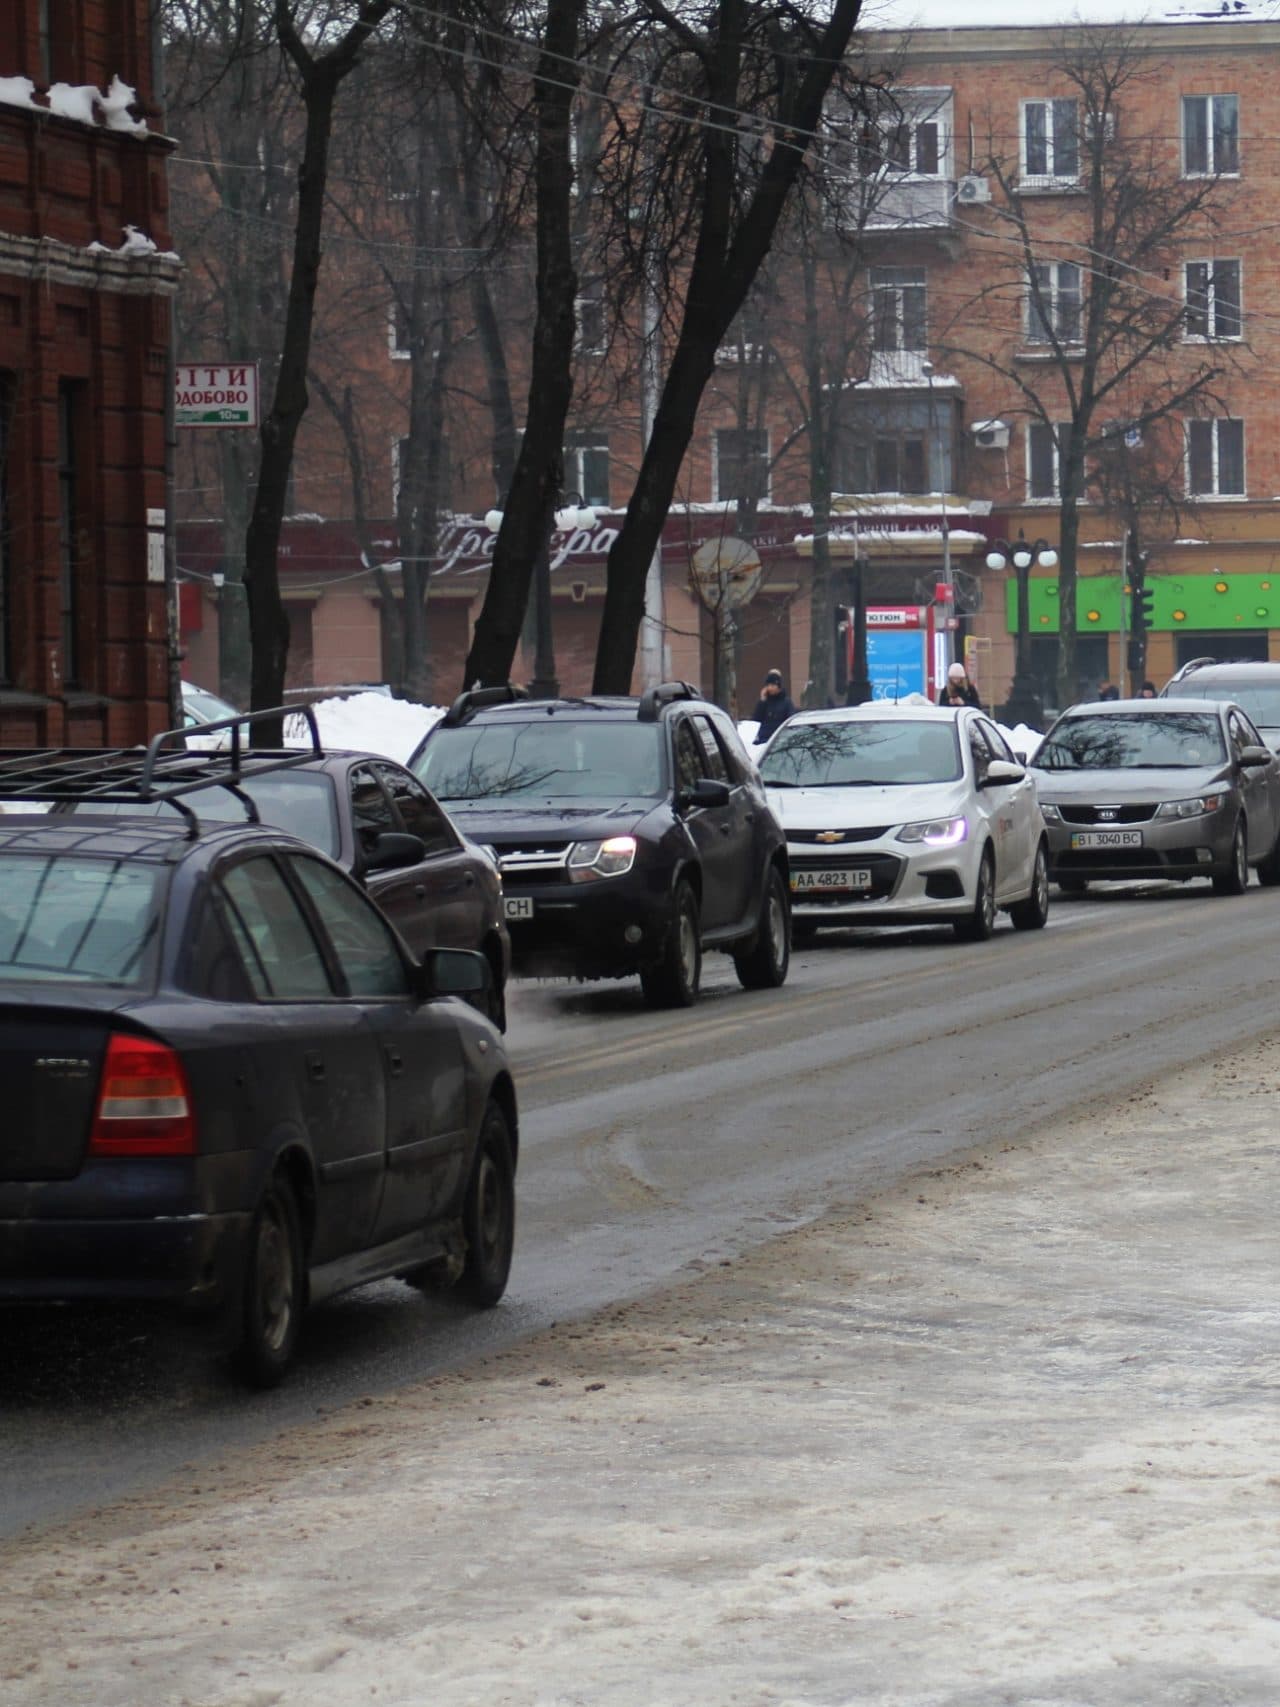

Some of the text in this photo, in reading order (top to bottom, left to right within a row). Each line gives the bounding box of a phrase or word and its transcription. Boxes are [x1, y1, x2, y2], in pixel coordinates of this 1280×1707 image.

[1096, 834, 1121, 845] 3040
[1122, 833, 1139, 844] BC
[797, 874, 815, 887] AA
[817, 873, 847, 886] 4823
[506, 900, 529, 916] CH
